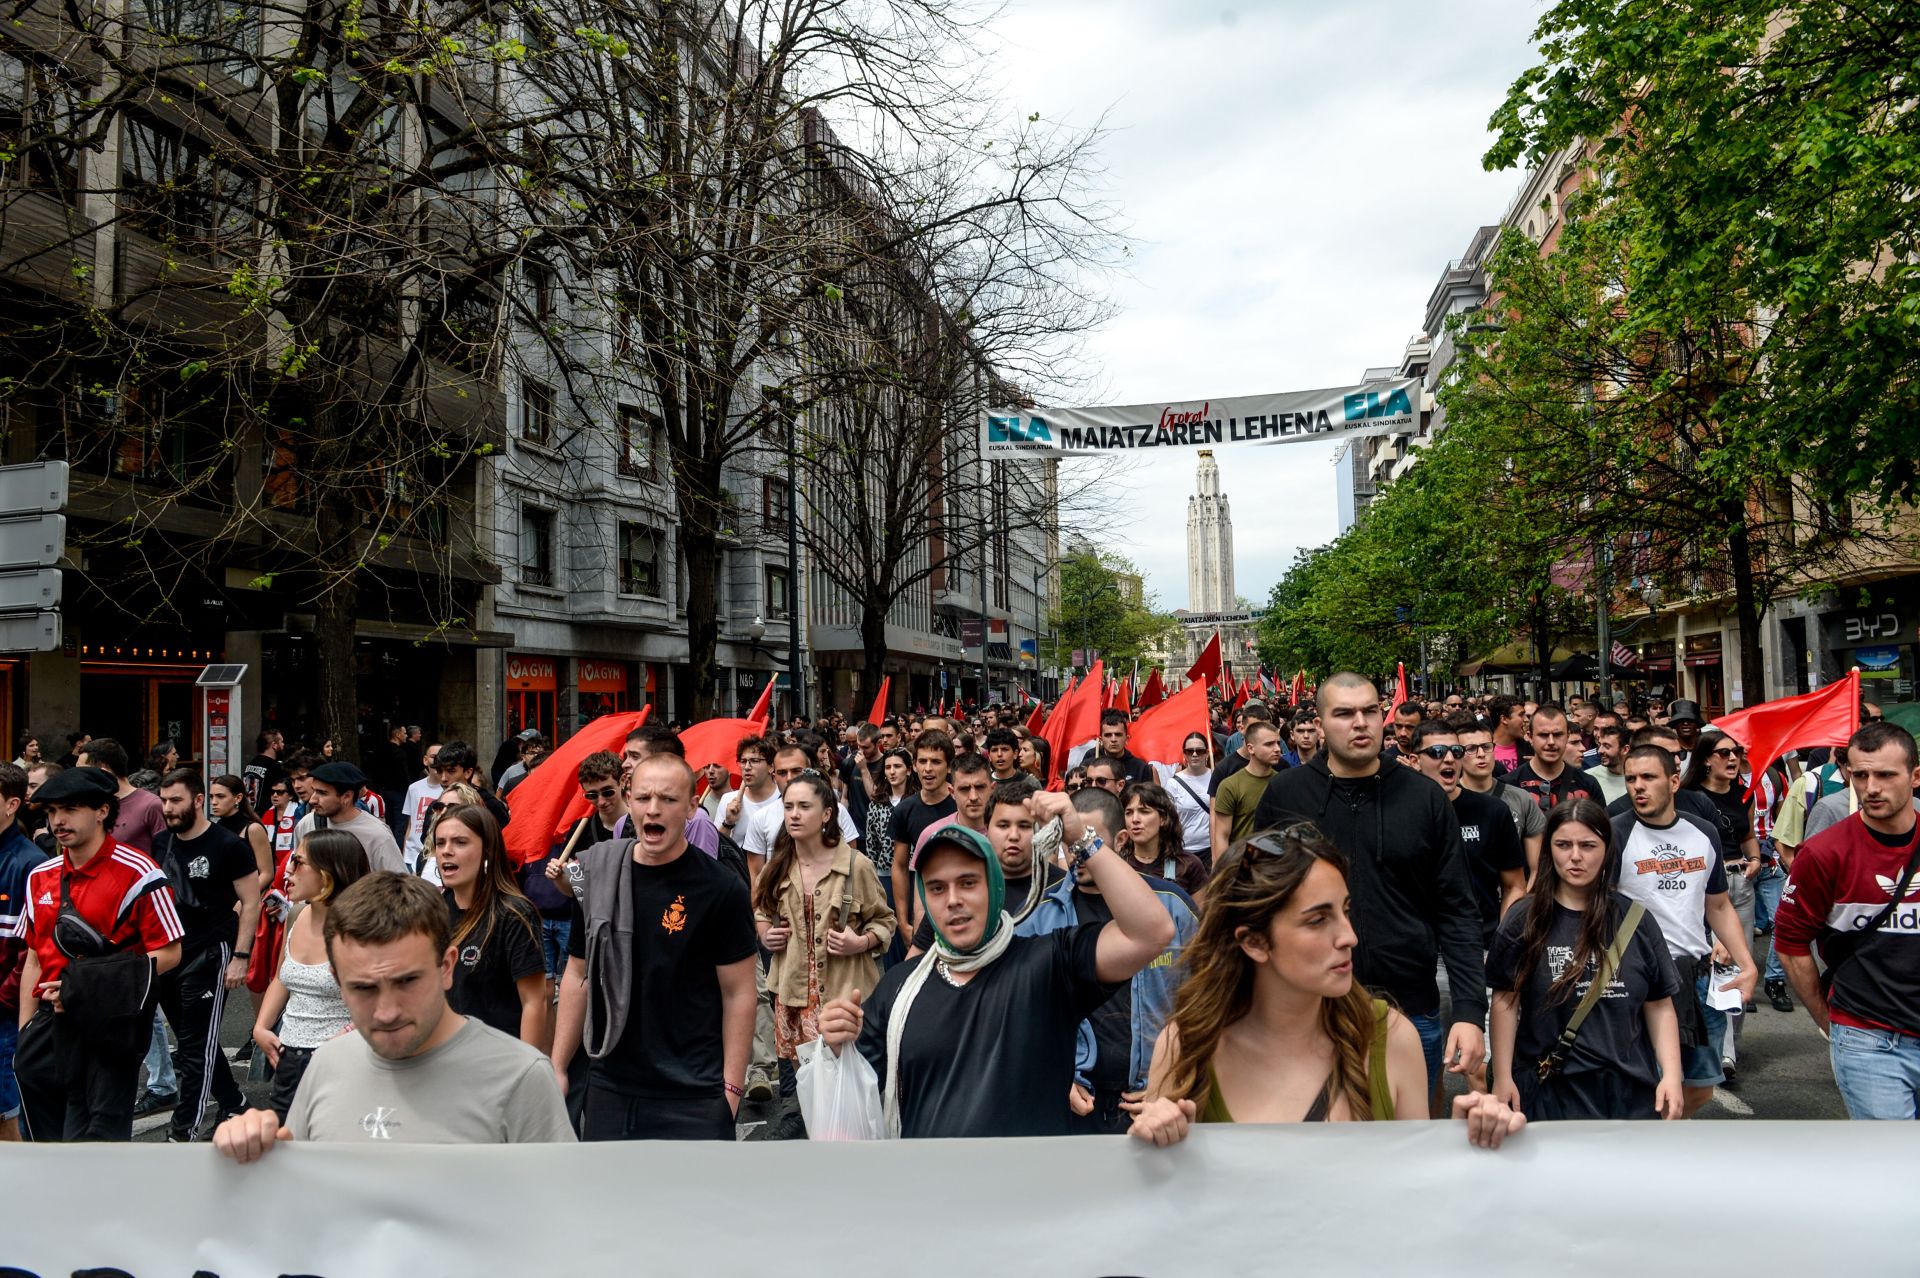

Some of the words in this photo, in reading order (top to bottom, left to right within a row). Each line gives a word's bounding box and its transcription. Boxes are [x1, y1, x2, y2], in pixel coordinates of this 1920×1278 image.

[1344, 388, 1412, 421] ELA
[1161, 402, 1209, 432] Gora!
[1345, 422, 1371, 430] EUSKAL
[1373, 418, 1412, 428] SINDIKATUA
[987, 417, 1052, 442] ELA
[1061, 419, 1223, 449] MAIATZAREN
[1230, 410, 1334, 441] LEHENA
[1222, 614, 1249, 622] LEHENA
[1845, 613, 1899, 640] BYD
[739, 674, 754, 687] N&G
[1650, 843, 1686, 857] BILBAO
[1657, 880, 1687, 890] 2020
[1853, 908, 1920, 930] aid
[363, 1106, 398, 1140] CK
